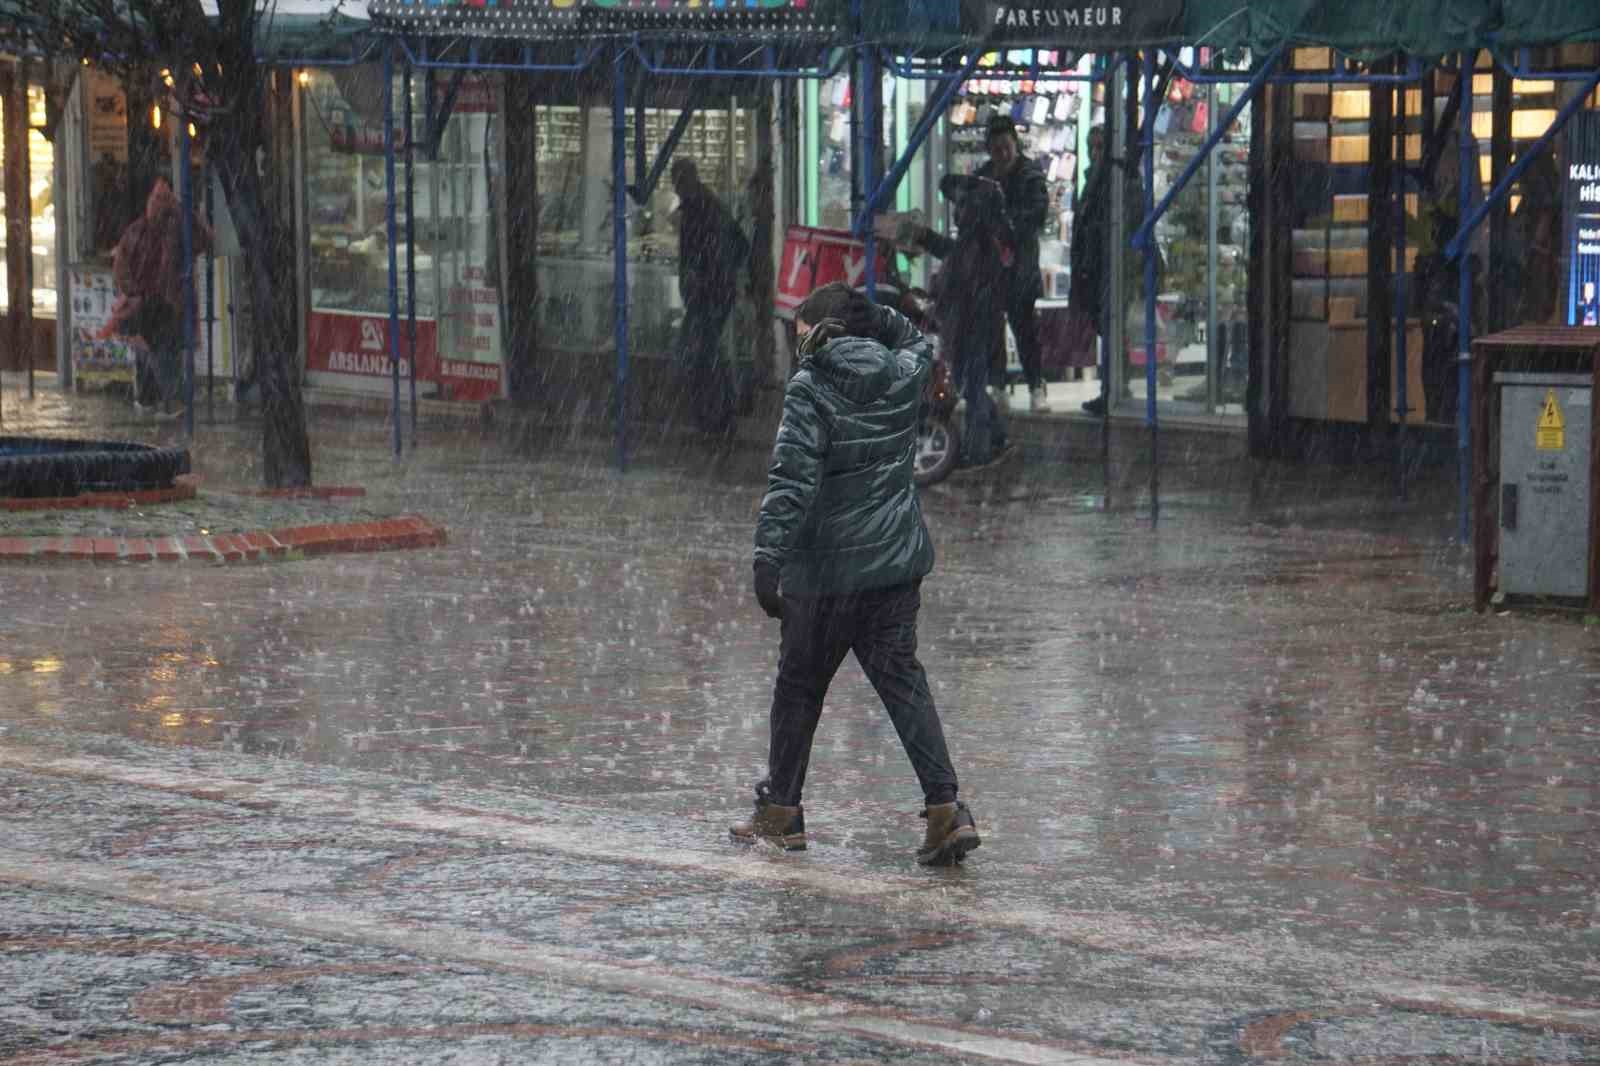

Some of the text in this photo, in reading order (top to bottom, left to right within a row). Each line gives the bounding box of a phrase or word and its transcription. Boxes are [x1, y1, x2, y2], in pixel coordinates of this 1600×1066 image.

[994, 6, 1122, 26] PARFUMEUR
[1569, 164, 1600, 181] KALI
[328, 351, 413, 377] ARSLANZD
